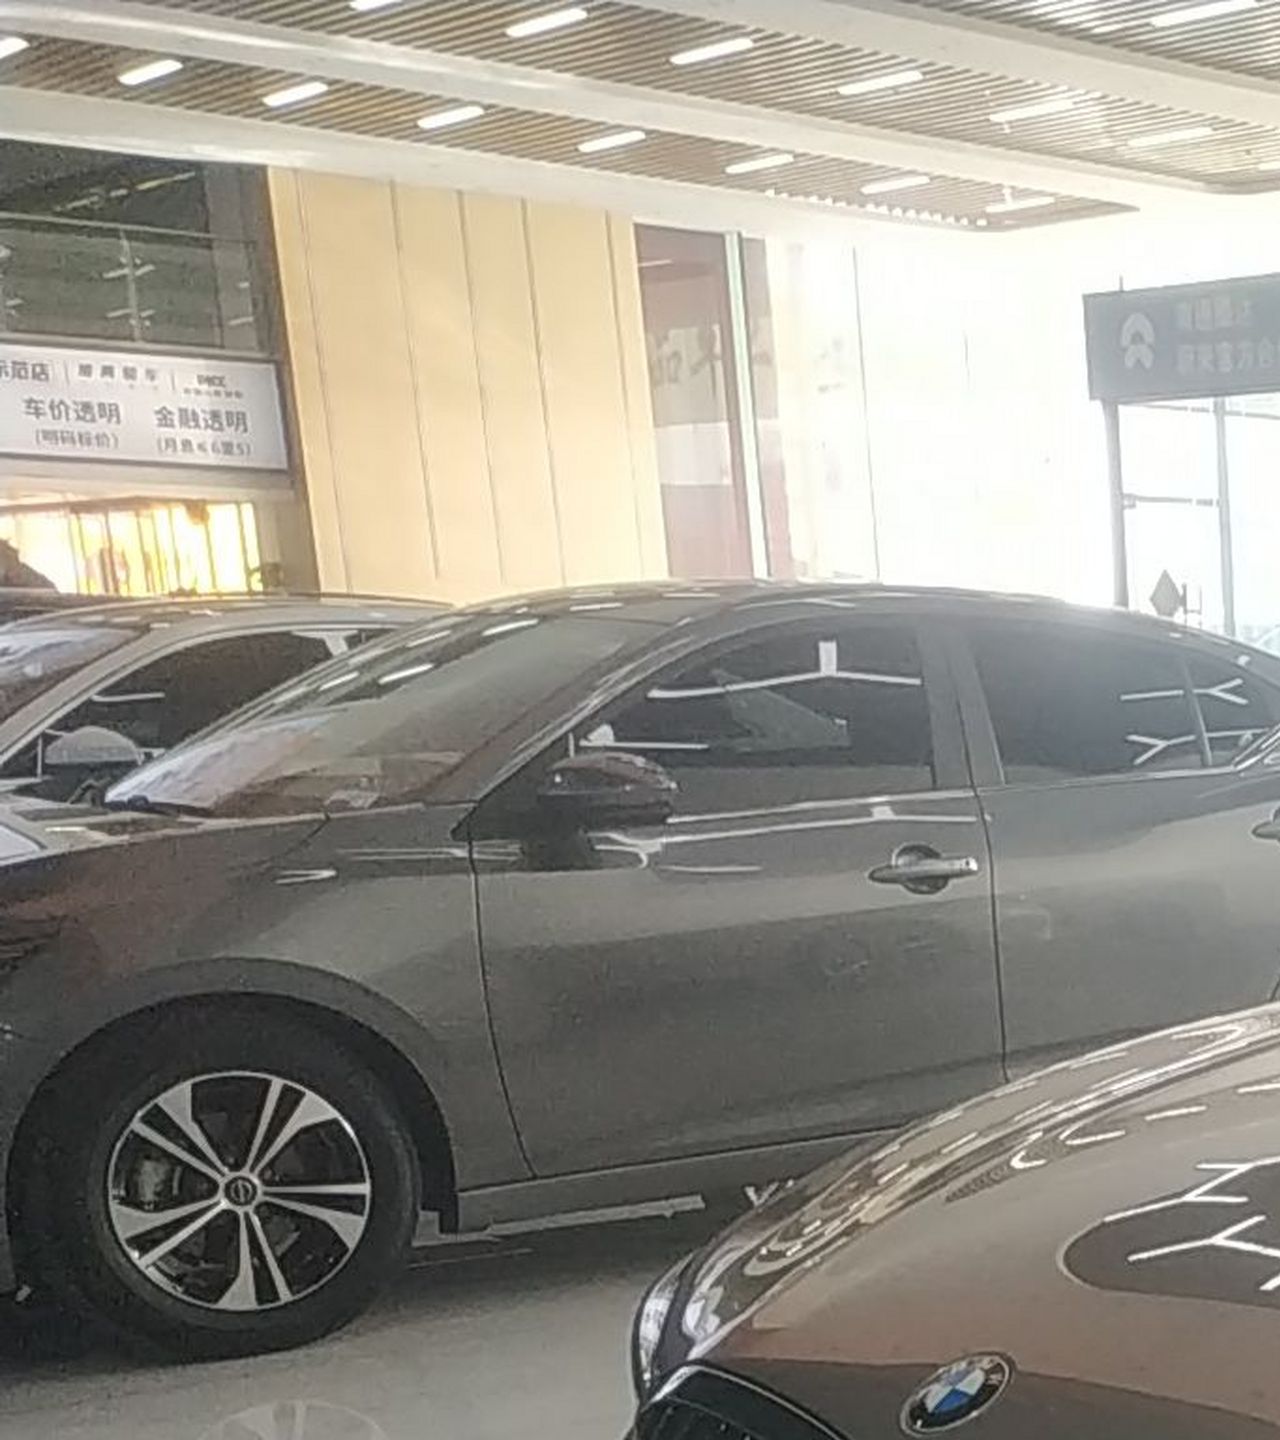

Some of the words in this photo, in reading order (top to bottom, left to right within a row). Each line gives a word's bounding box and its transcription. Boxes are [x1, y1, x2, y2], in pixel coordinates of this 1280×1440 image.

[22, 399, 121, 424] 车价透明
[154, 406, 248, 433] 金融透明
